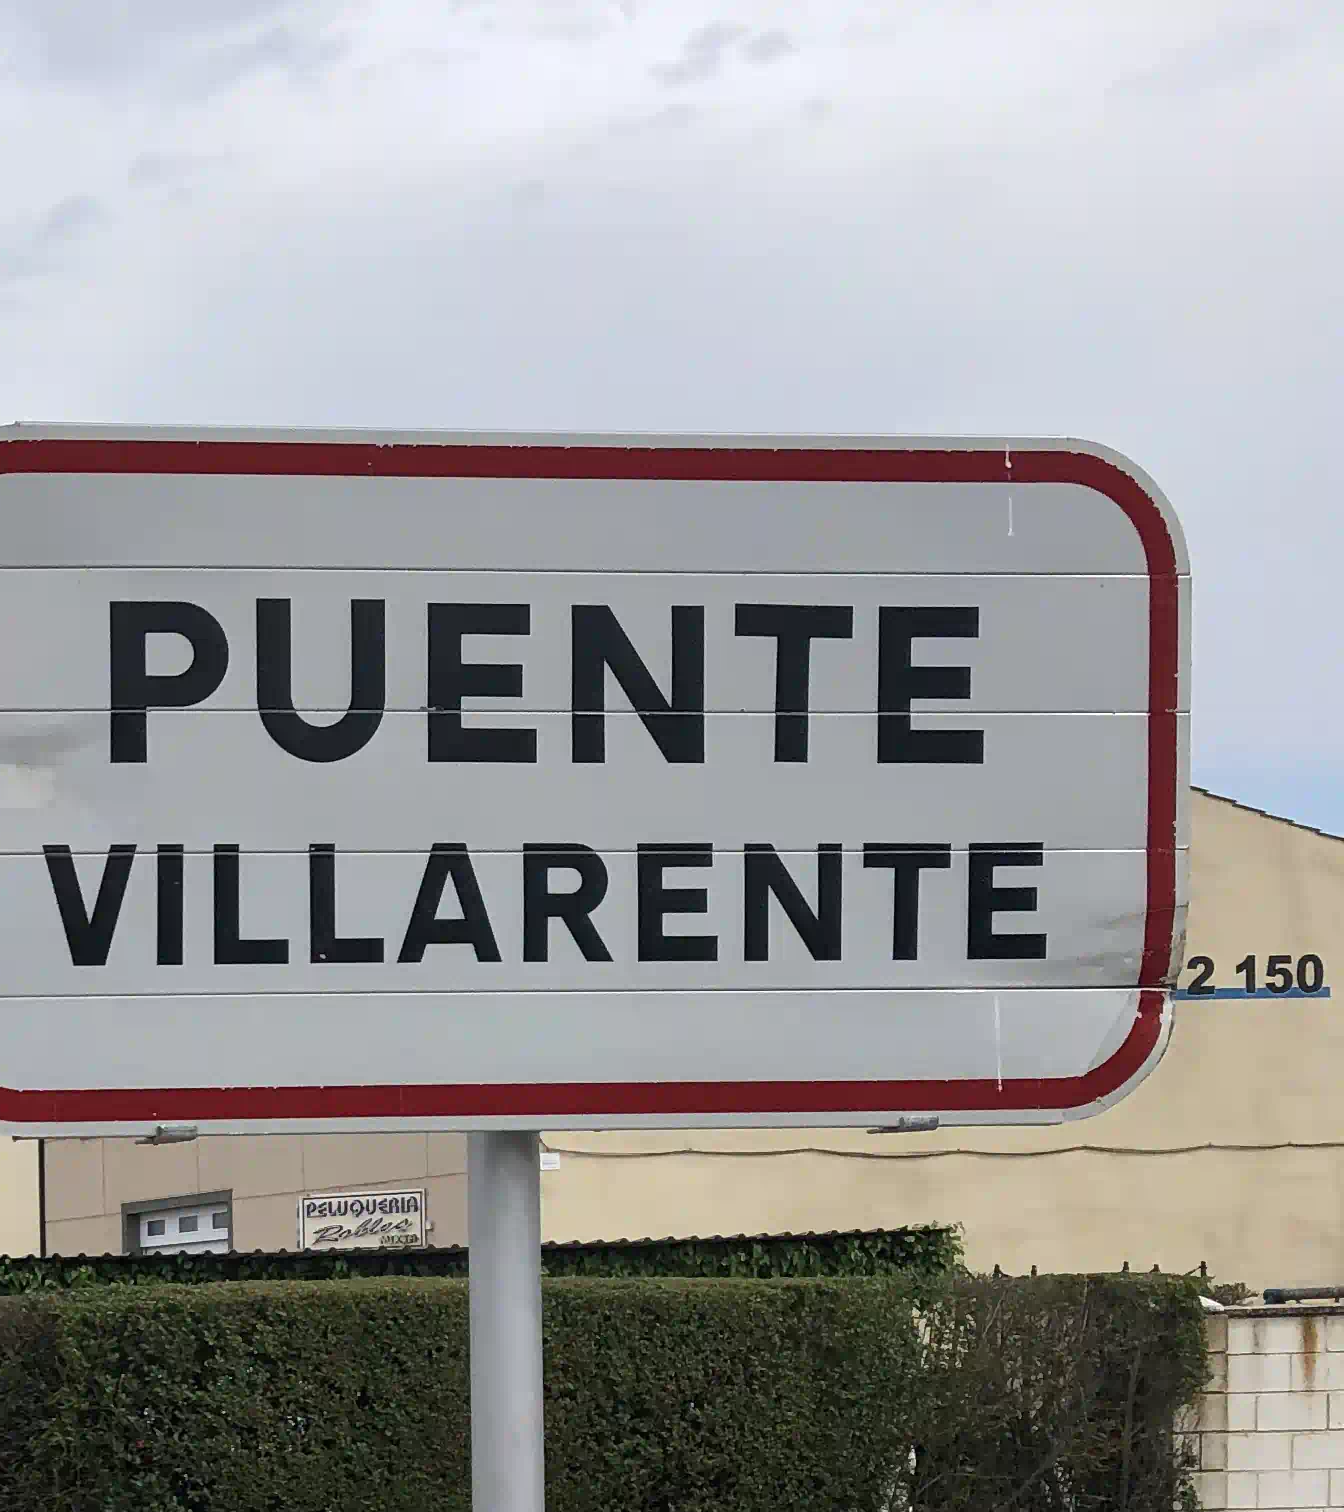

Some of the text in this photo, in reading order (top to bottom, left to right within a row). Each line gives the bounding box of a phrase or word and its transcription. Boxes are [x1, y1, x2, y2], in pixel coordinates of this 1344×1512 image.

[109, 598, 984, 765] PUENTE
[42, 841, 1048, 967] VILLARENTE
[1235, 953, 1324, 994] 150
[306, 1196, 419, 1218] PELUQUERIA
